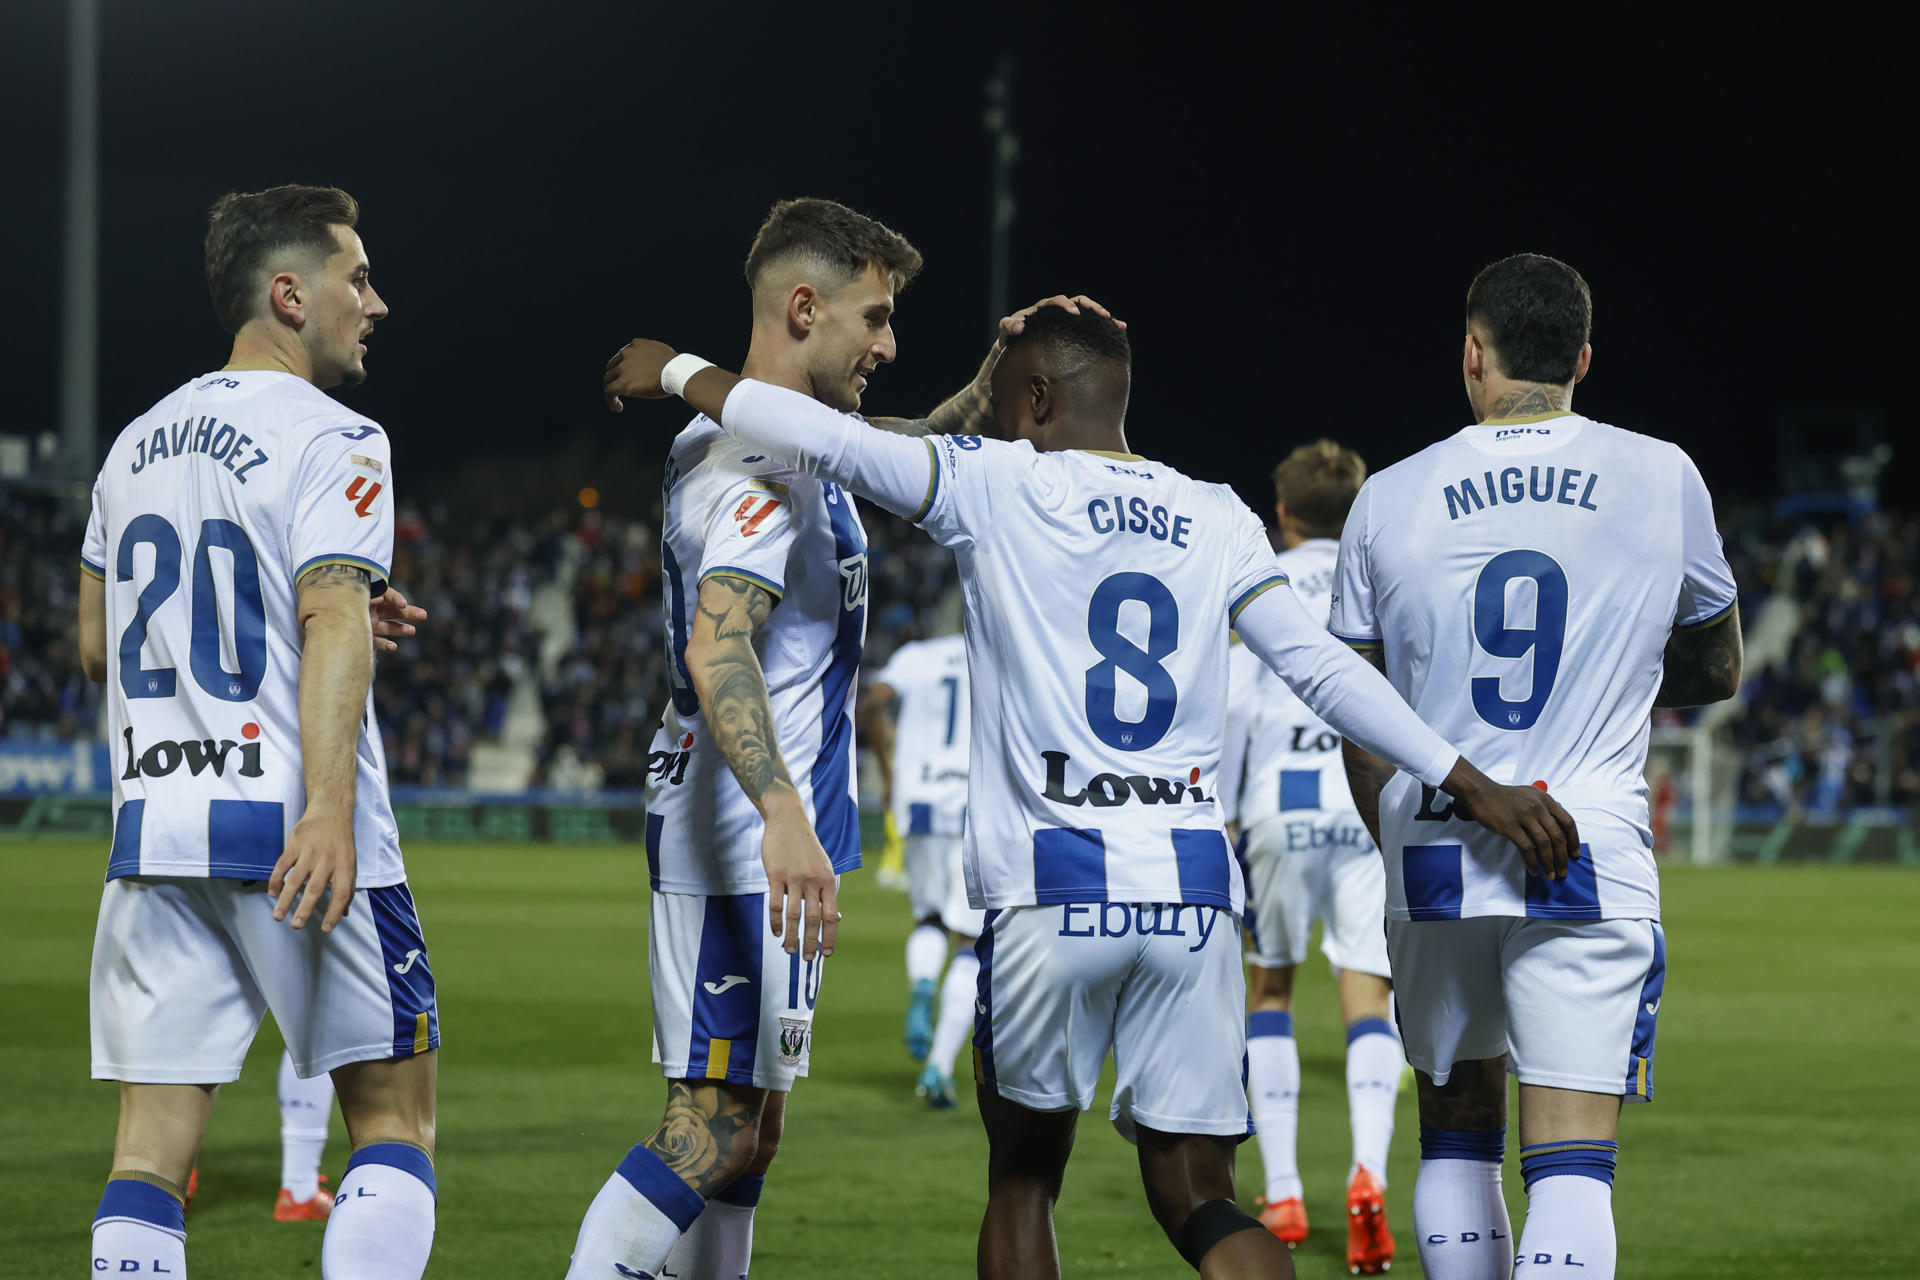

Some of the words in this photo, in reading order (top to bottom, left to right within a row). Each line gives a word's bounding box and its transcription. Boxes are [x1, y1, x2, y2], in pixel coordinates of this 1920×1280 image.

[1443, 466, 1598, 520] MIGUEL
[1088, 496, 1192, 549] CISSE
[117, 513, 267, 703] 20
[1085, 571, 1179, 751] 8
[1471, 549, 1569, 732] 9
[1041, 751, 1214, 807] Lowi
[1059, 902, 1218, 952] Ebury
